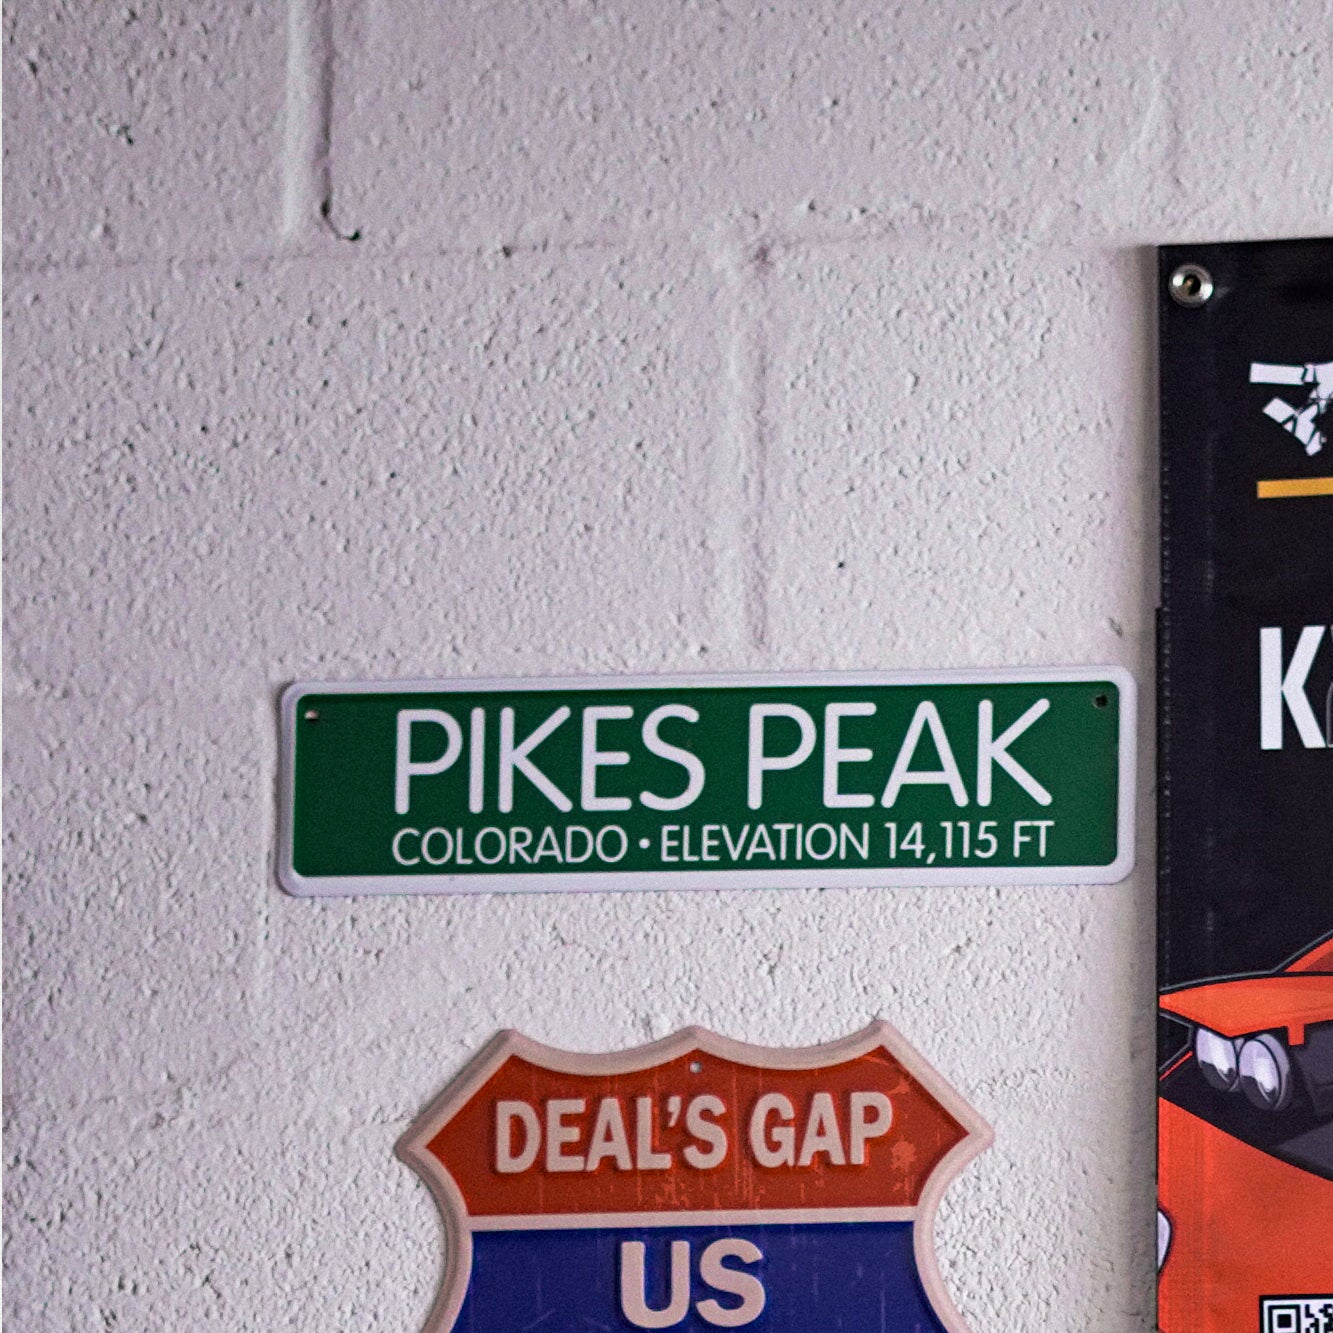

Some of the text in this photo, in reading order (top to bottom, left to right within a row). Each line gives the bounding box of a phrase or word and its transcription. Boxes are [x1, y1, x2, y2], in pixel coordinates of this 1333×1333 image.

[396, 698, 1053, 814] PIKES PEAK
[391, 820, 1055, 868] COLORADO ELEVATION 14,115 FT
[496, 1090, 894, 1174] DEAL'S GAP
[620, 1237, 767, 1330] US
